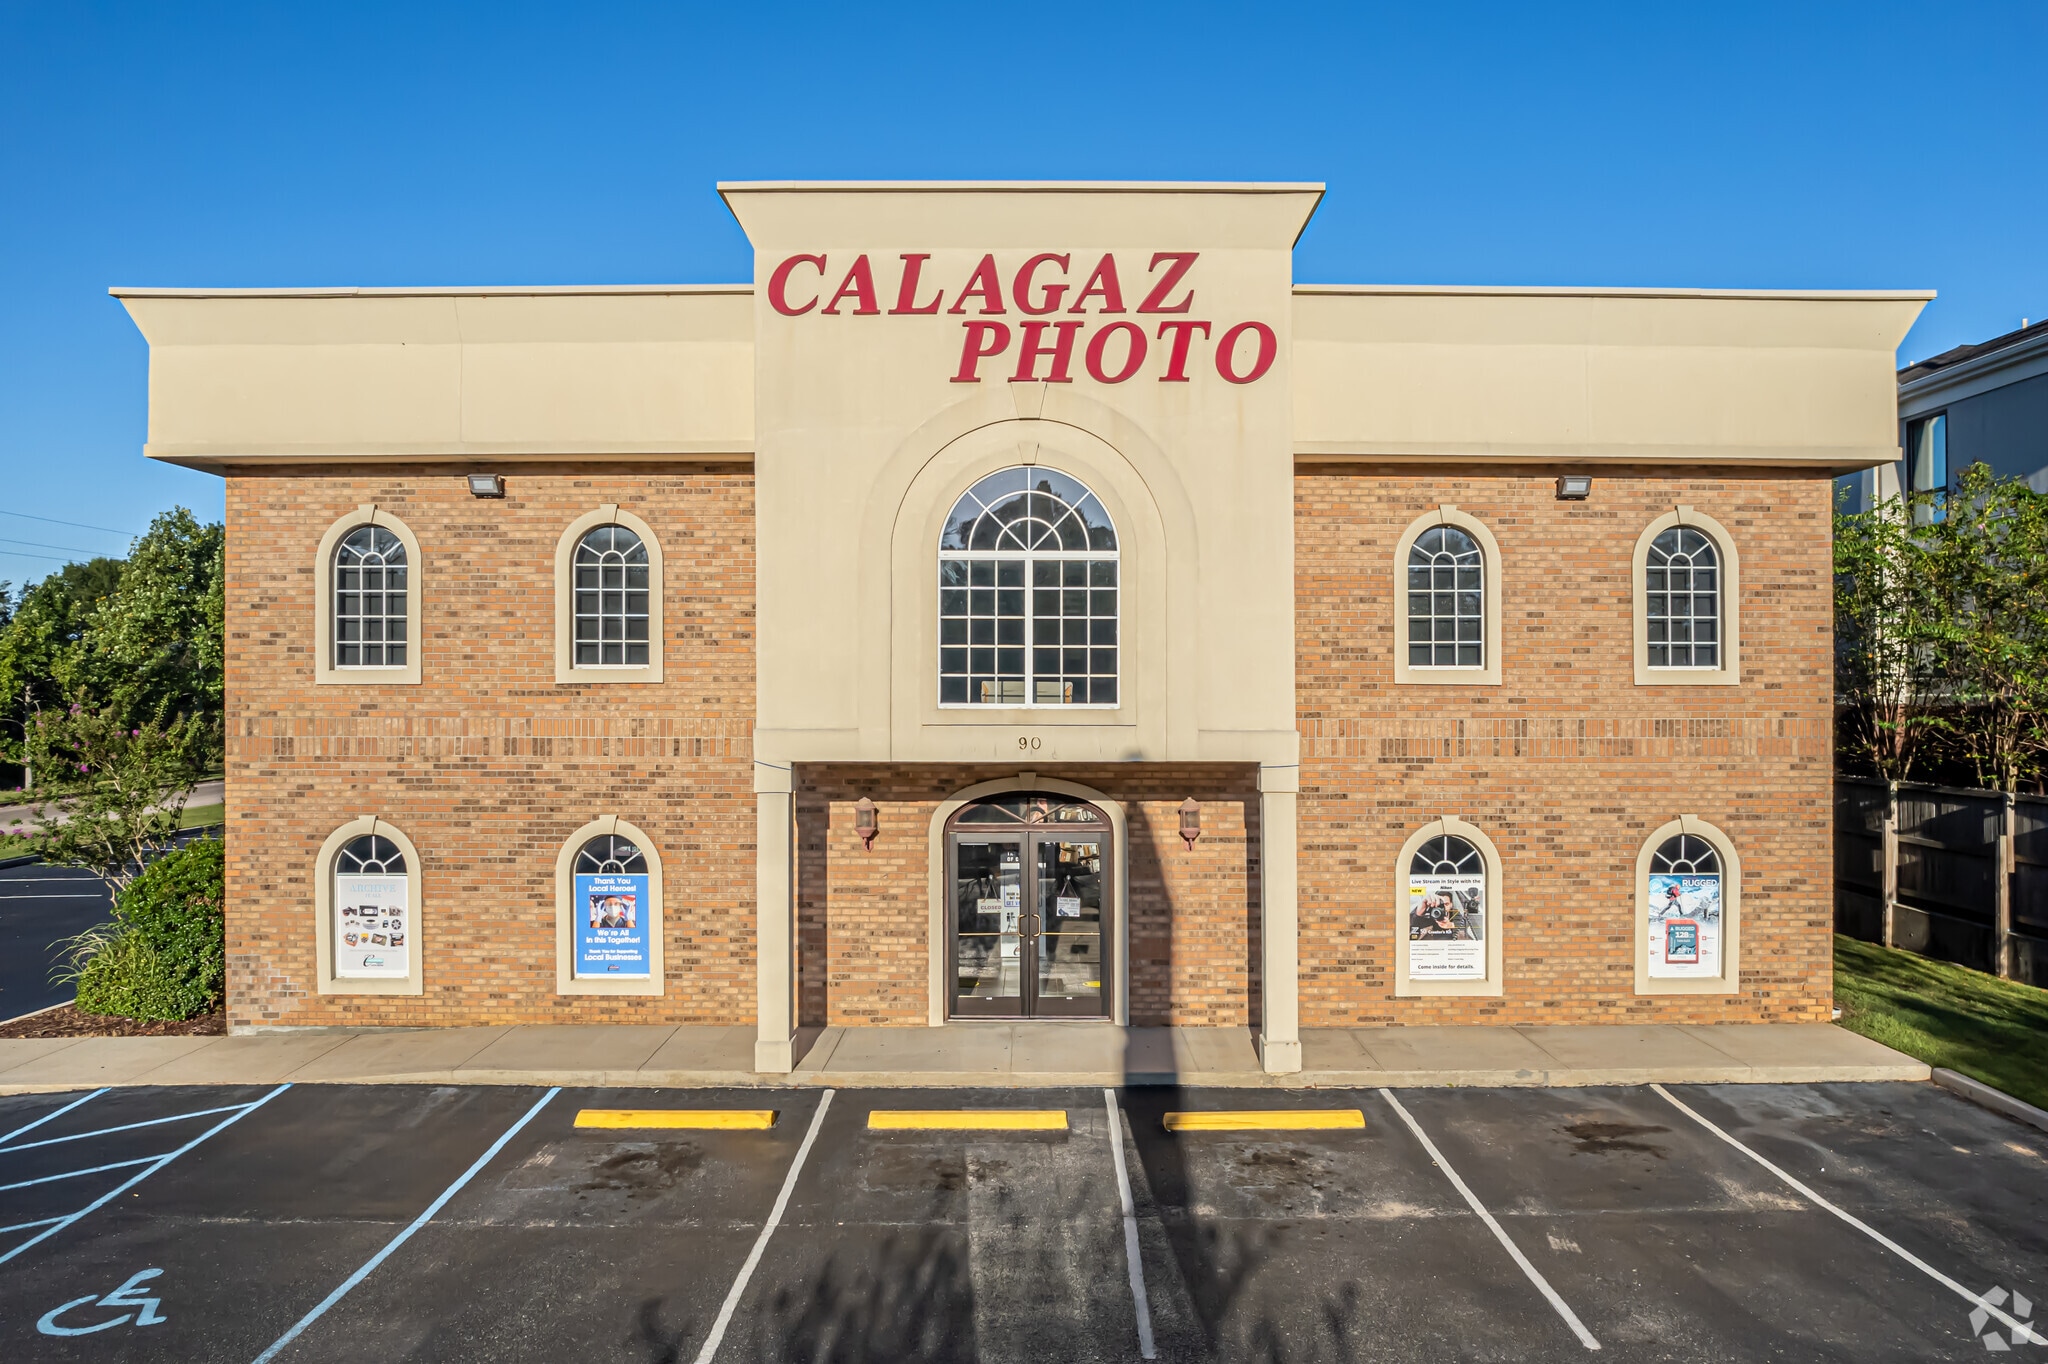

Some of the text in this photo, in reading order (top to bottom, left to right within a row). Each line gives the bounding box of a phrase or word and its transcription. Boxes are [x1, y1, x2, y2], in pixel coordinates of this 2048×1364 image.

[768, 252, 1199, 315] CALAGAZ
[950, 320, 1277, 384] PHOTO
[1019, 737, 1041, 750] 90
[350, 884, 396, 892] ARCHIVE
